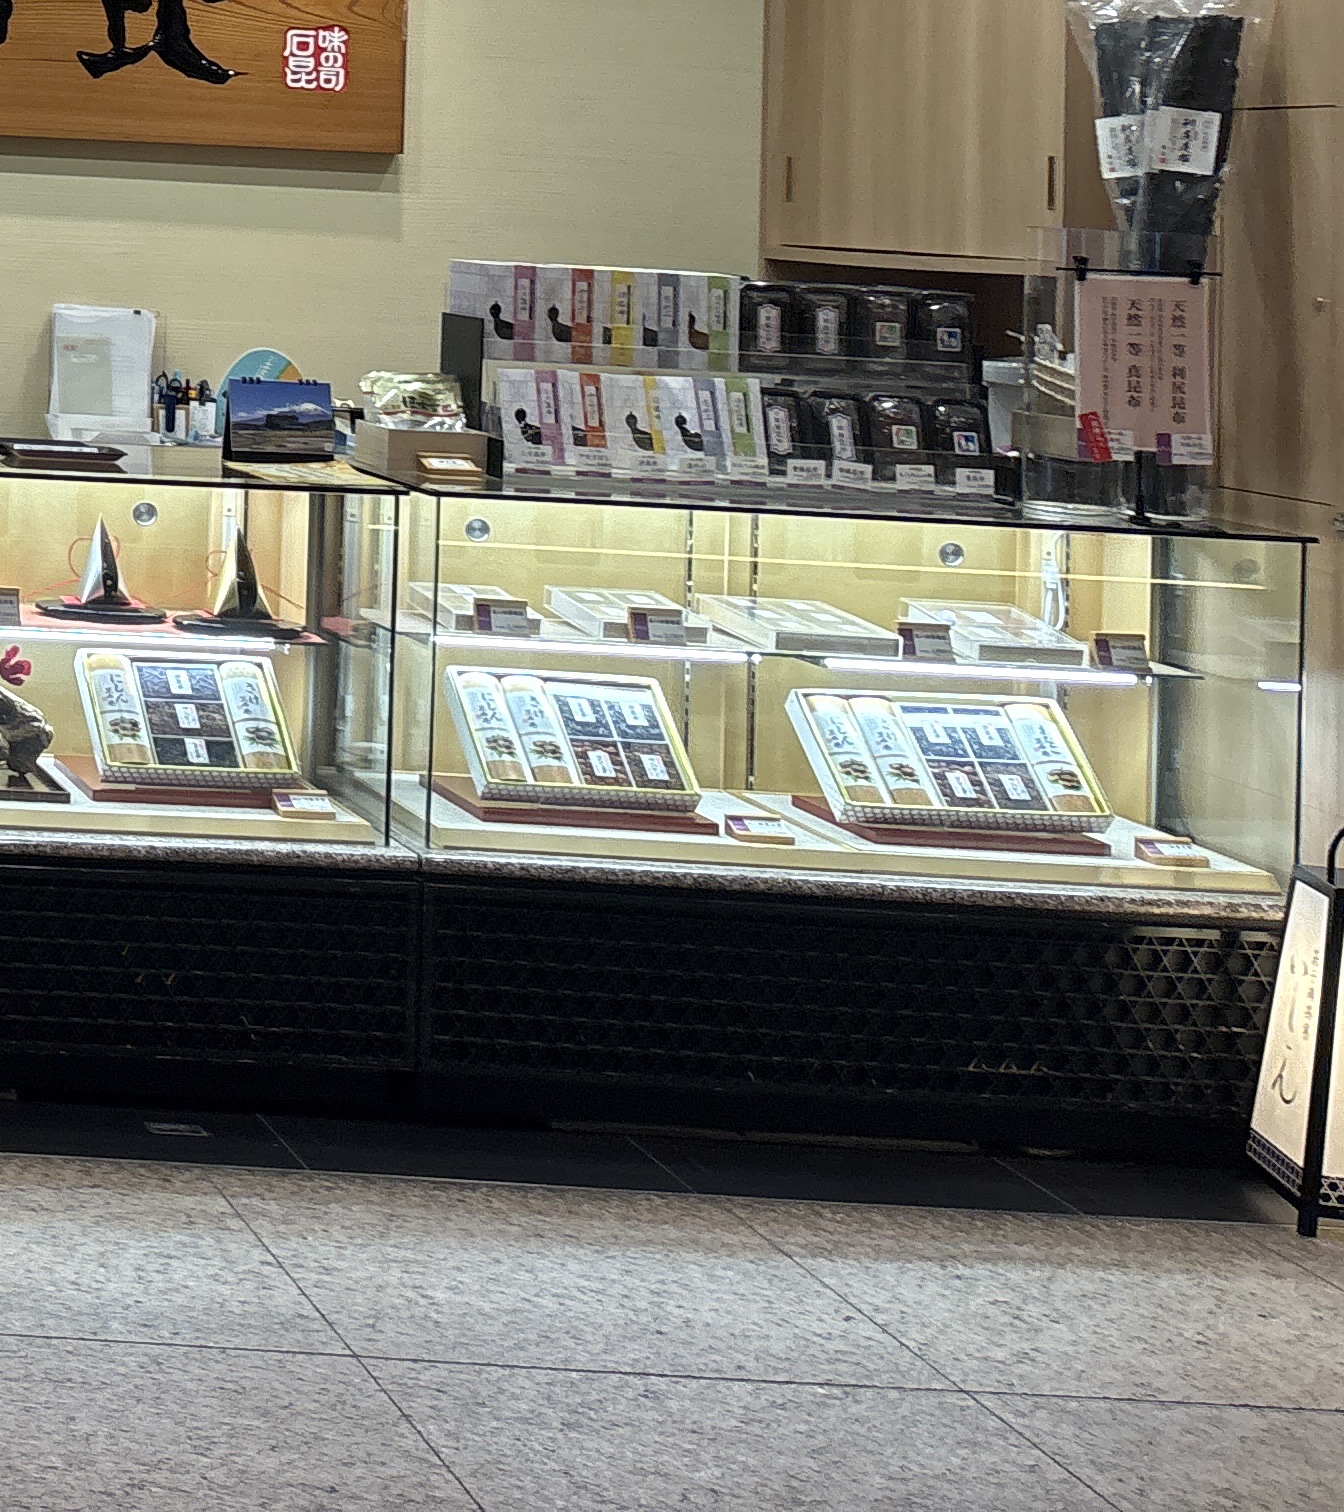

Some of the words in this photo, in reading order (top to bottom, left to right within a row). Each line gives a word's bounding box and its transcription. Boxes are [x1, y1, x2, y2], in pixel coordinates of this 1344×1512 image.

[283, 29, 318, 88] 石昆
[317, 26, 349, 91] 味の司
